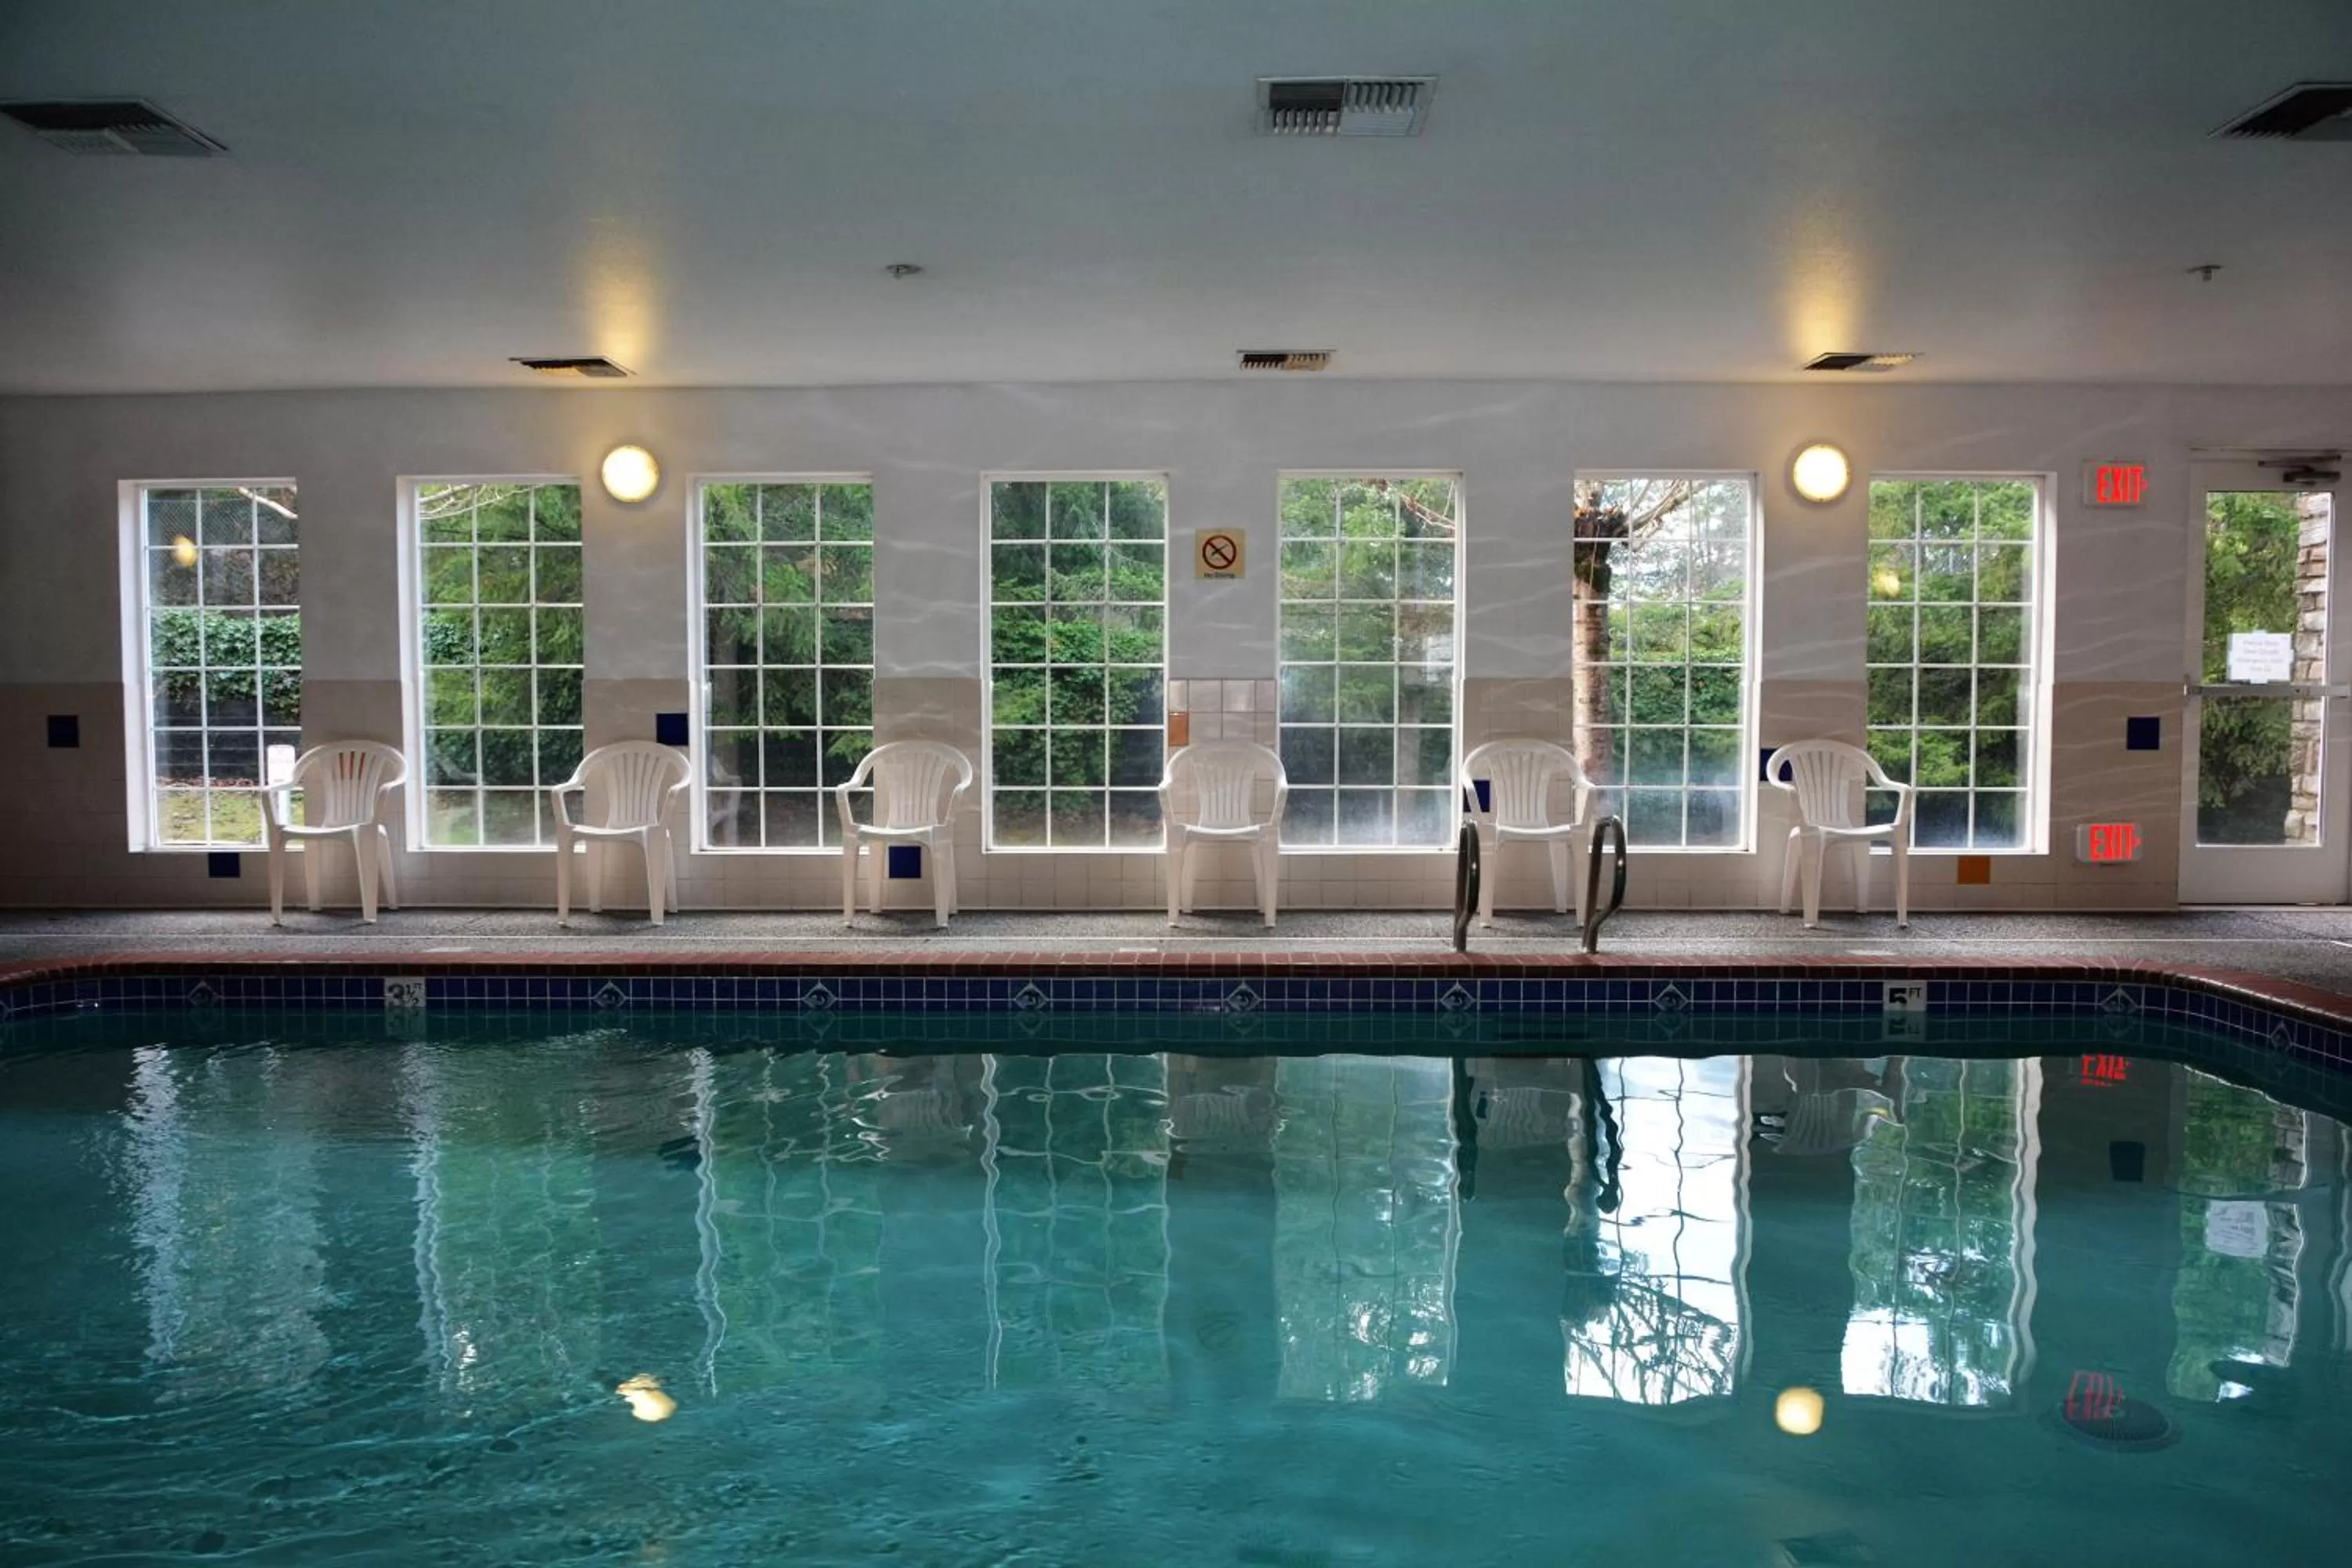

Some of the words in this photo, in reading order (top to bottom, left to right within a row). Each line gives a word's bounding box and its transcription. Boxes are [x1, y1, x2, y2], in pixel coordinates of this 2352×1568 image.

[2097, 466, 2143, 503] EXIT
[2089, 824, 2133, 861] EXIT
[1889, 987, 1907, 1008] 5
